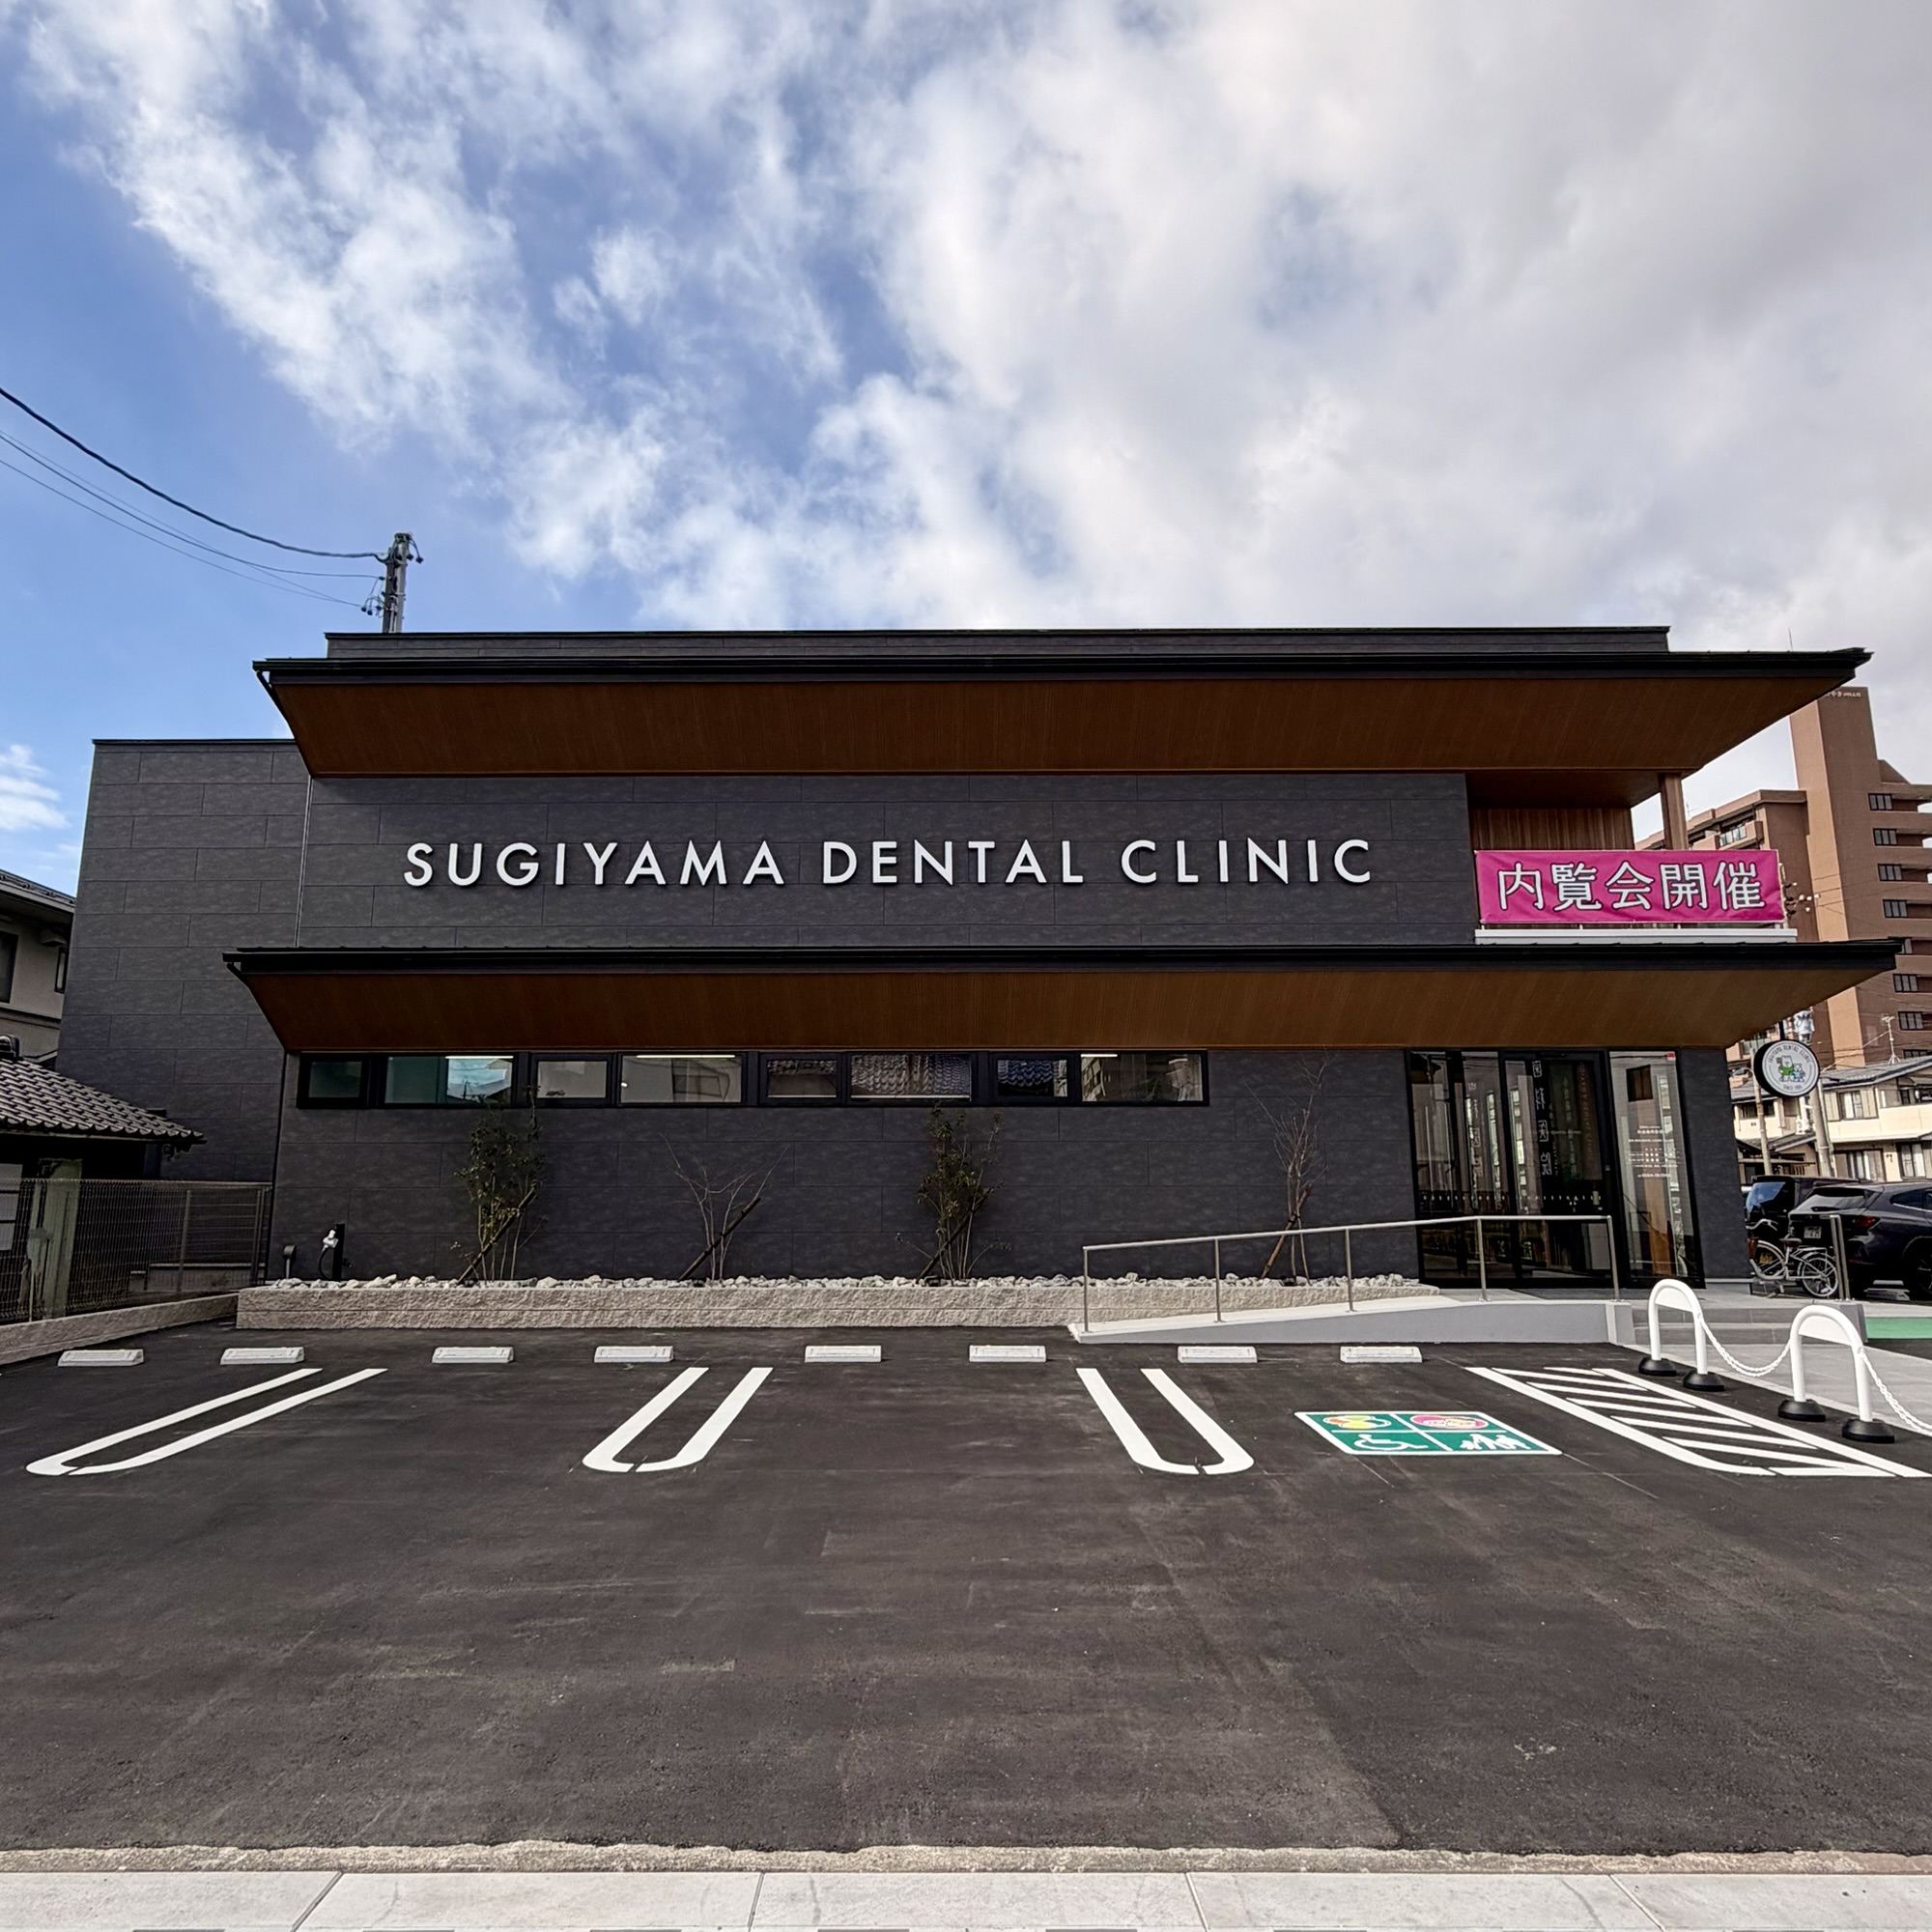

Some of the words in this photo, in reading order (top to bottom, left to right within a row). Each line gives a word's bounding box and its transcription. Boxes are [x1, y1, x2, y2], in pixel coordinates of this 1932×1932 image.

[404, 838, 784, 887] SUGIYAMA
[822, 838, 1084, 886] DENTAL
[1120, 838, 1371, 885] CLINIC
[1497, 860, 1766, 911] 内覧会開催
